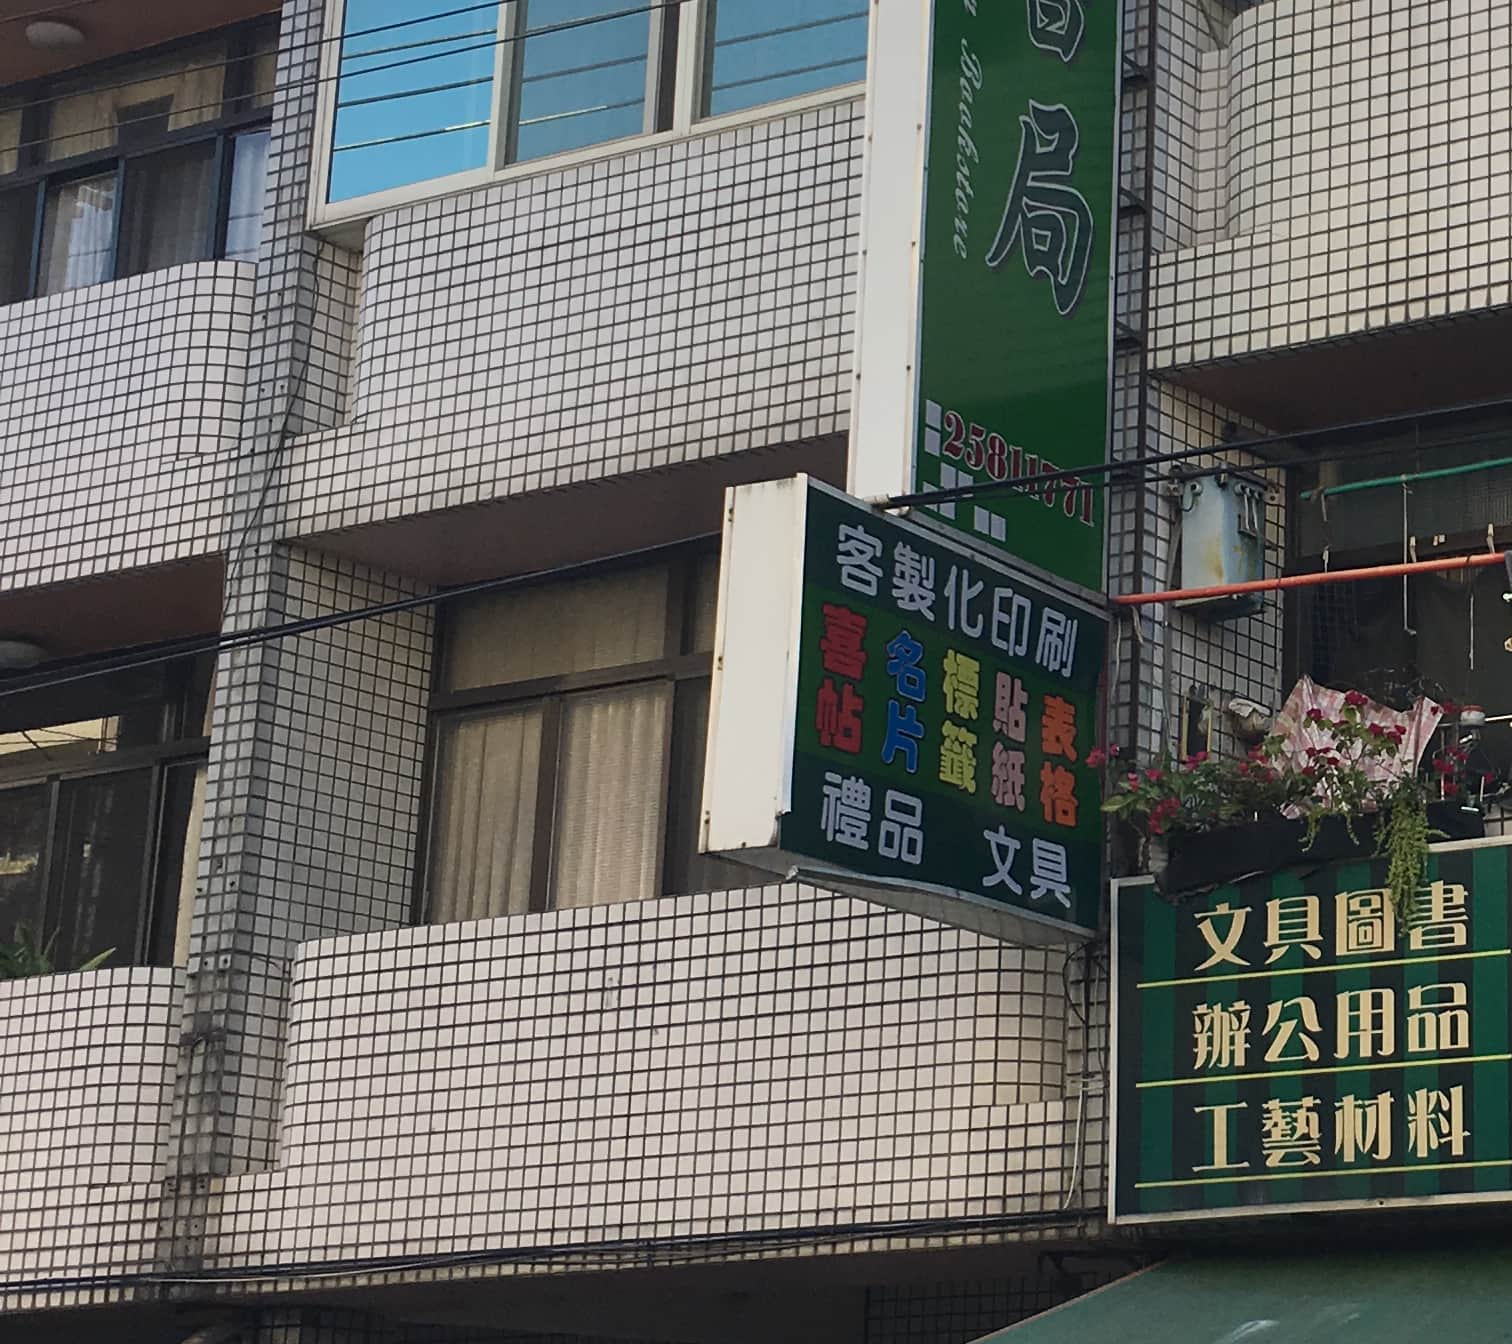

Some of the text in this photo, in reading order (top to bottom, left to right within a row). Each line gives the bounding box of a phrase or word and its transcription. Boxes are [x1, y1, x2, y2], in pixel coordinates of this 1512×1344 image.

[951, 38, 985, 260] Bookstore
[835, 523, 1080, 678] 客製化印刷
[815, 602, 869, 755] 喜帖
[881, 629, 927, 774] 名片
[939, 647, 981, 795] 標籤
[991, 670, 1029, 813] 貼紙
[1039, 693, 1079, 829] 表格
[820, 770, 1073, 909] 禮品 文具
[1193, 878, 1471, 972] 文具圖書
[1192, 981, 1471, 1071] 辦公用品
[1191, 1085, 1472, 1173] 工藝材料
